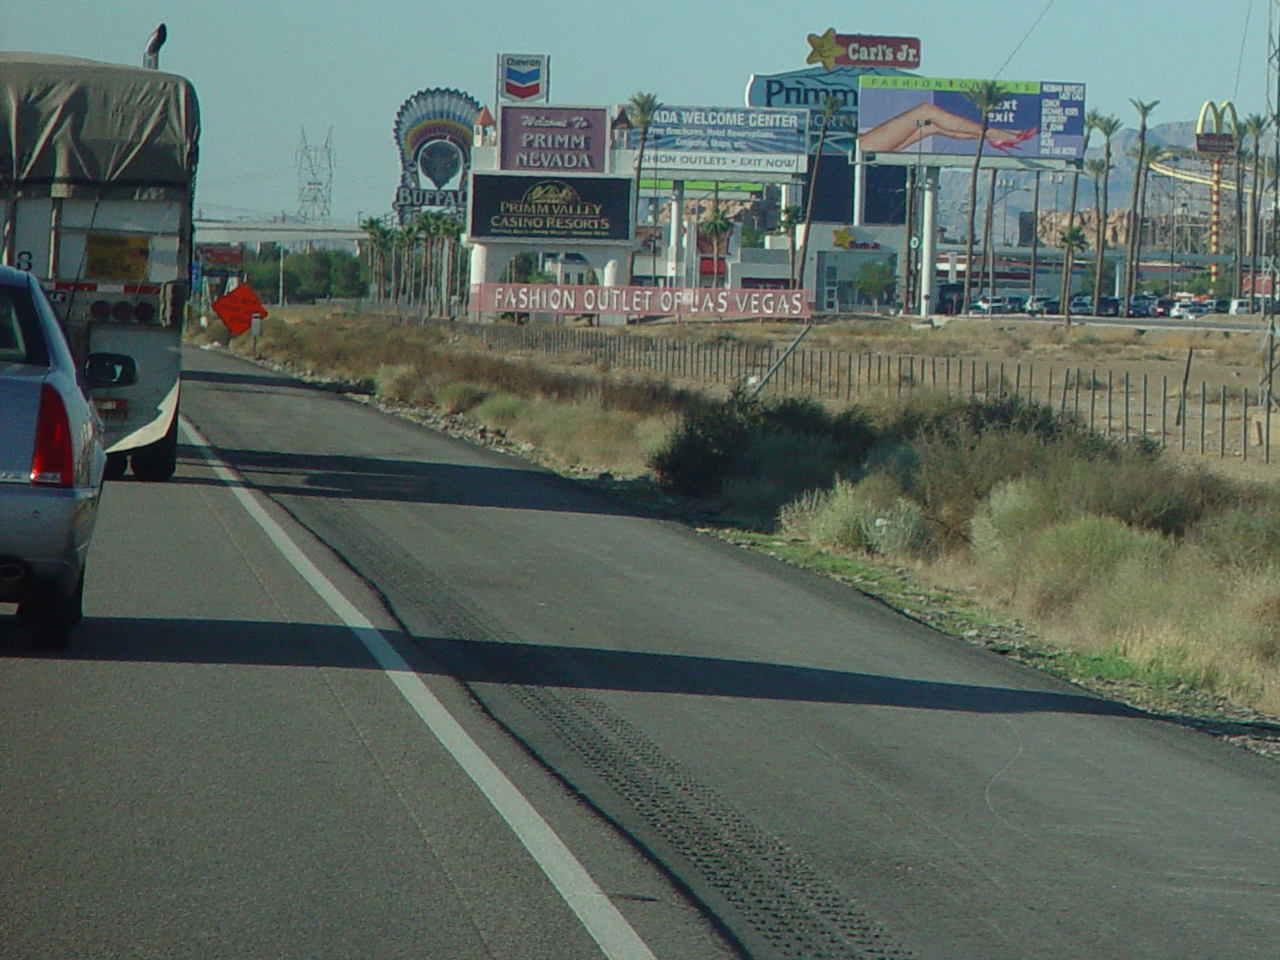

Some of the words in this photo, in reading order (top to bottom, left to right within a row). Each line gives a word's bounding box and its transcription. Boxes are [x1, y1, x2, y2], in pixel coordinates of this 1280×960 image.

[848, 42, 894, 62] Carl's
[896, 43, 919, 63] Jr.
[506, 57, 541, 67] Chevron
[991, 99, 1018, 111] ext
[652, 109, 677, 123] ADA
[682, 111, 745, 126] WELCOME
[749, 113, 798, 128] CENTER
[987, 111, 1015, 123] exit
[522, 132, 586, 149] PRIMM
[516, 151, 591, 168] NEVADA
[634, 153, 676, 164] SHION
[680, 155, 727, 165] OUTLETS
[740, 158, 762, 167] EXIT
[766, 159, 795, 167] NOW
[399, 188, 468, 206] BUFFAL
[500, 201, 549, 214] PRIMM
[552, 204, 602, 215] VALLEY
[491, 216, 543, 228] CASINO
[546, 218, 610, 230] RESORTS
[495, 288, 575, 310] FASHION
[583, 289, 651, 311] OUTLET
[660, 290, 681, 313] OF
[690, 290, 728, 313] LAS
[735, 292, 802, 315] VEGAS
